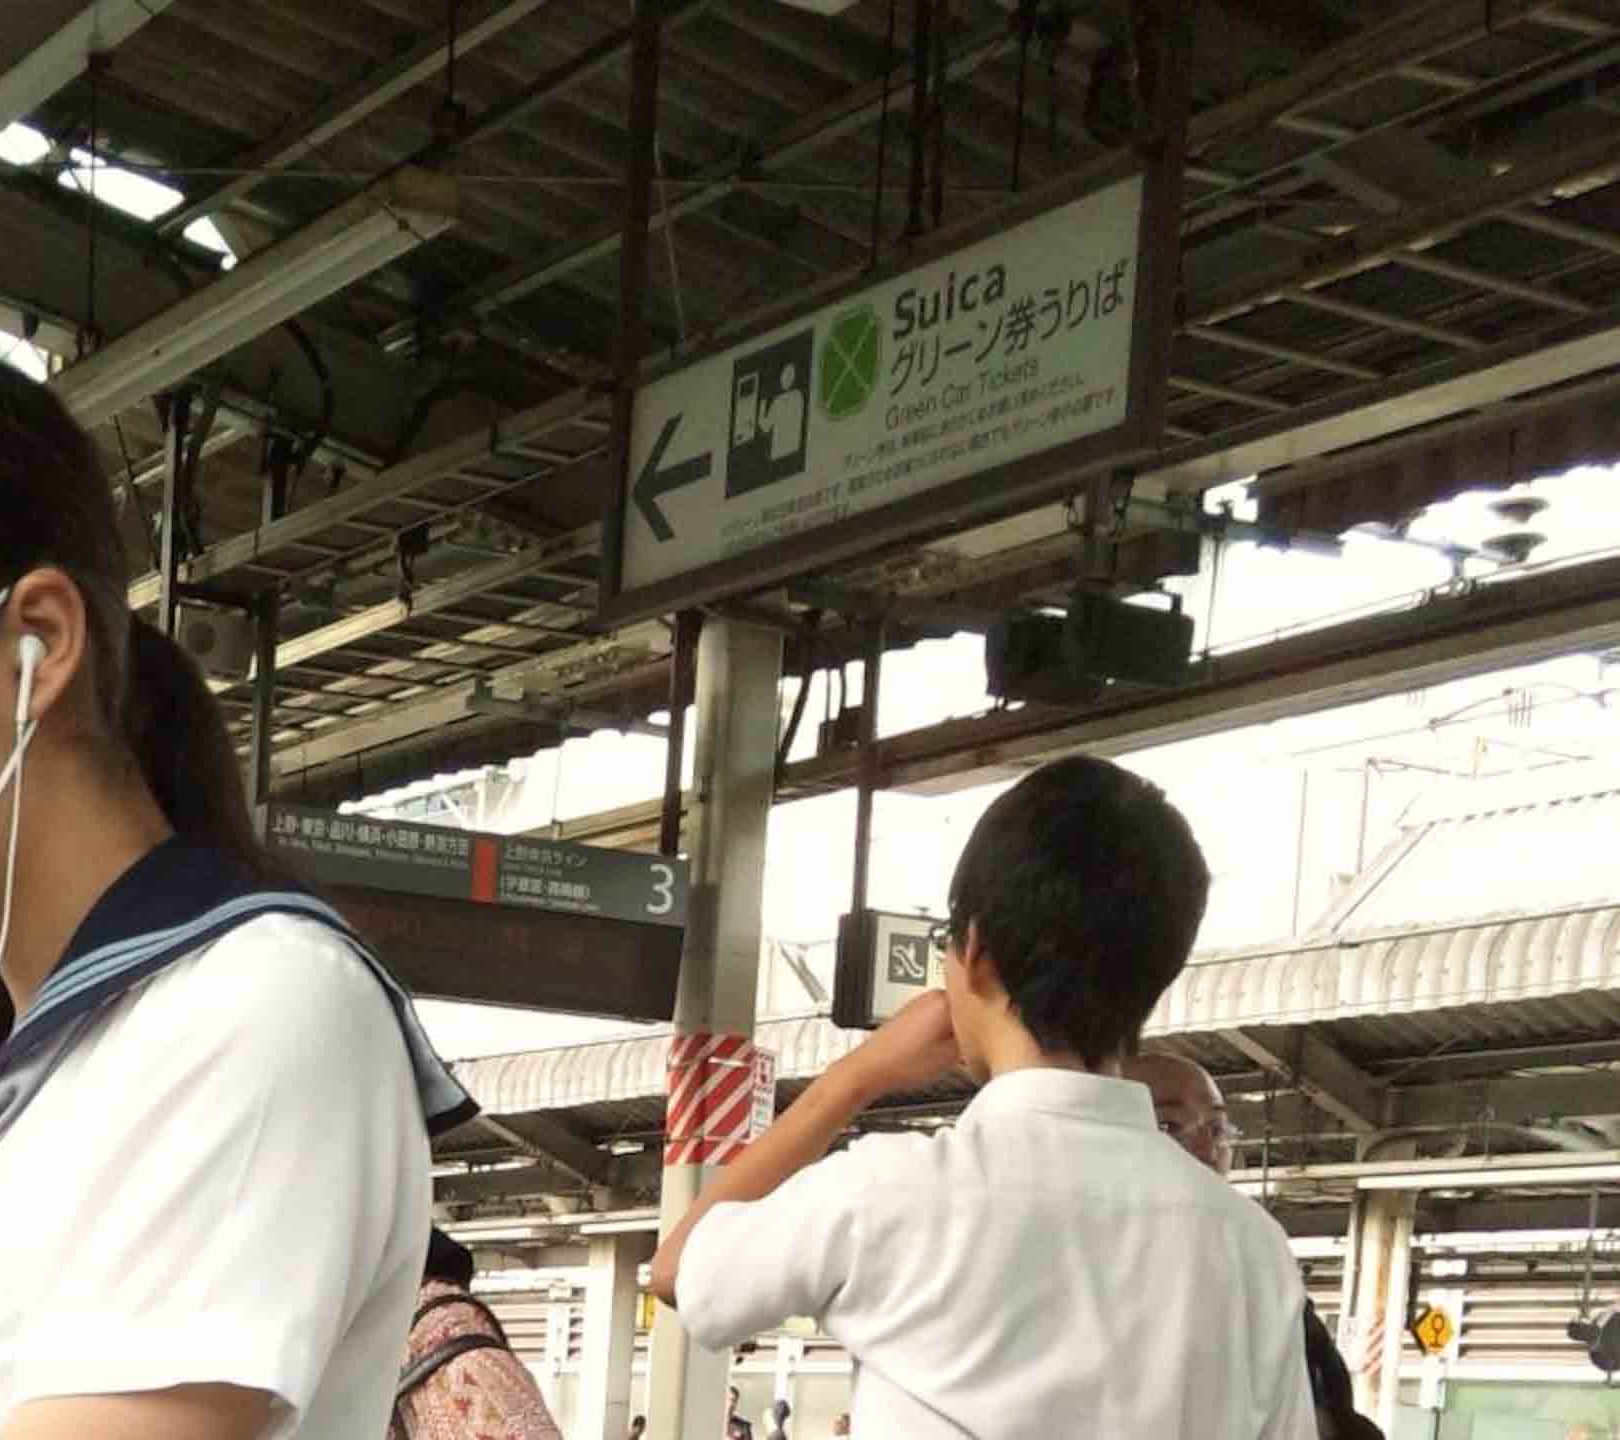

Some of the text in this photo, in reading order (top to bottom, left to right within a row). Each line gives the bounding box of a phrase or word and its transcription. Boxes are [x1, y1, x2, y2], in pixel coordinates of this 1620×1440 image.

[890, 258, 1132, 396] グリーン券うりば
[893, 264, 1006, 341] Suica
[646, 863, 674, 915] 3
